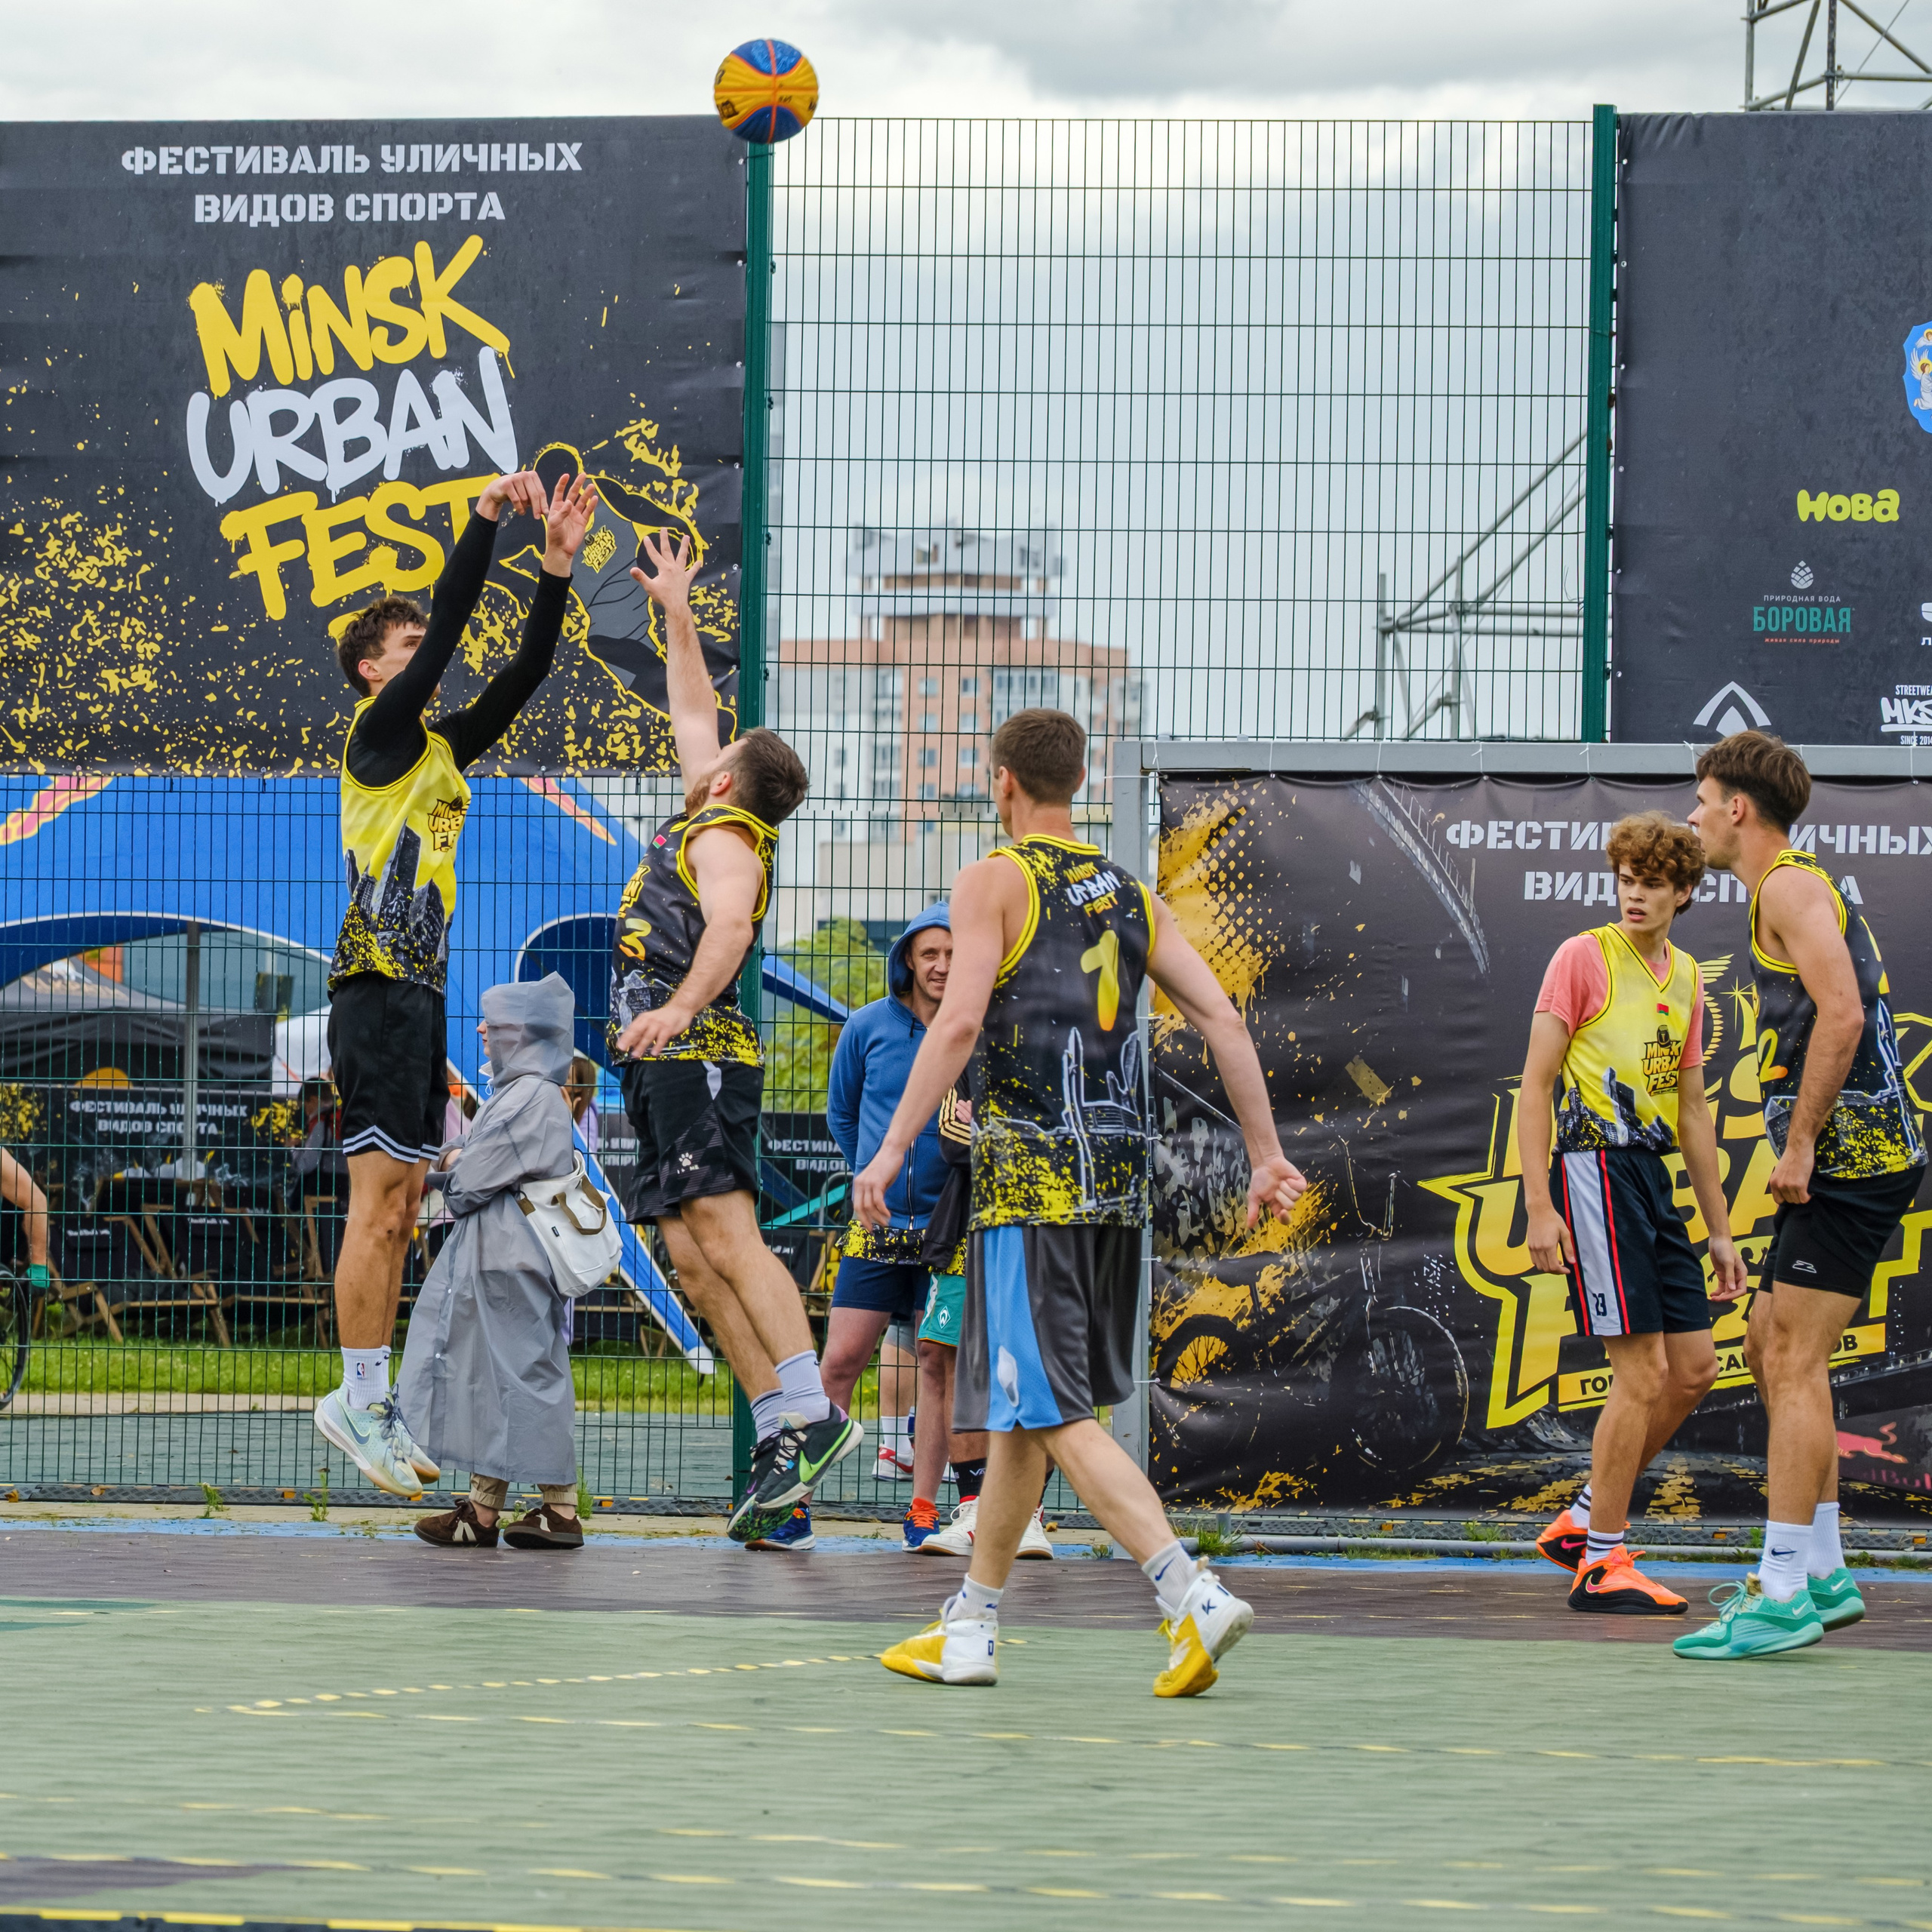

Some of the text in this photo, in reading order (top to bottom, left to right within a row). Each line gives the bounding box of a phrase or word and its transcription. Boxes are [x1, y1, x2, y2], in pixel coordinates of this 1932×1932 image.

[122, 141, 583, 176] ФЕСТИВАЛЬ УЛИЧНЫХ
[195, 191, 506, 228] ВИДОВ СПОРТА
[186, 346, 518, 507] URBAN
[1764, 595, 1841, 603] ПРИРОДНАЯ ВОДА
[1752, 606, 1851, 632] БОРОВАЯ
[1900, 735, 1918, 746] SINCE
[1446, 820, 1617, 851] ФЕСТИ
[1066, 870, 1121, 906] URBAN
[1524, 871, 1617, 906] ВИД
[619, 918, 652, 961] 3
[1080, 929, 1120, 1032] 1
[1757, 1029, 1789, 1083] 2
[69, 1100, 167, 1115] ФЕСТИВАЛЬ
[98, 1119, 153, 1134] ВИДОВ
